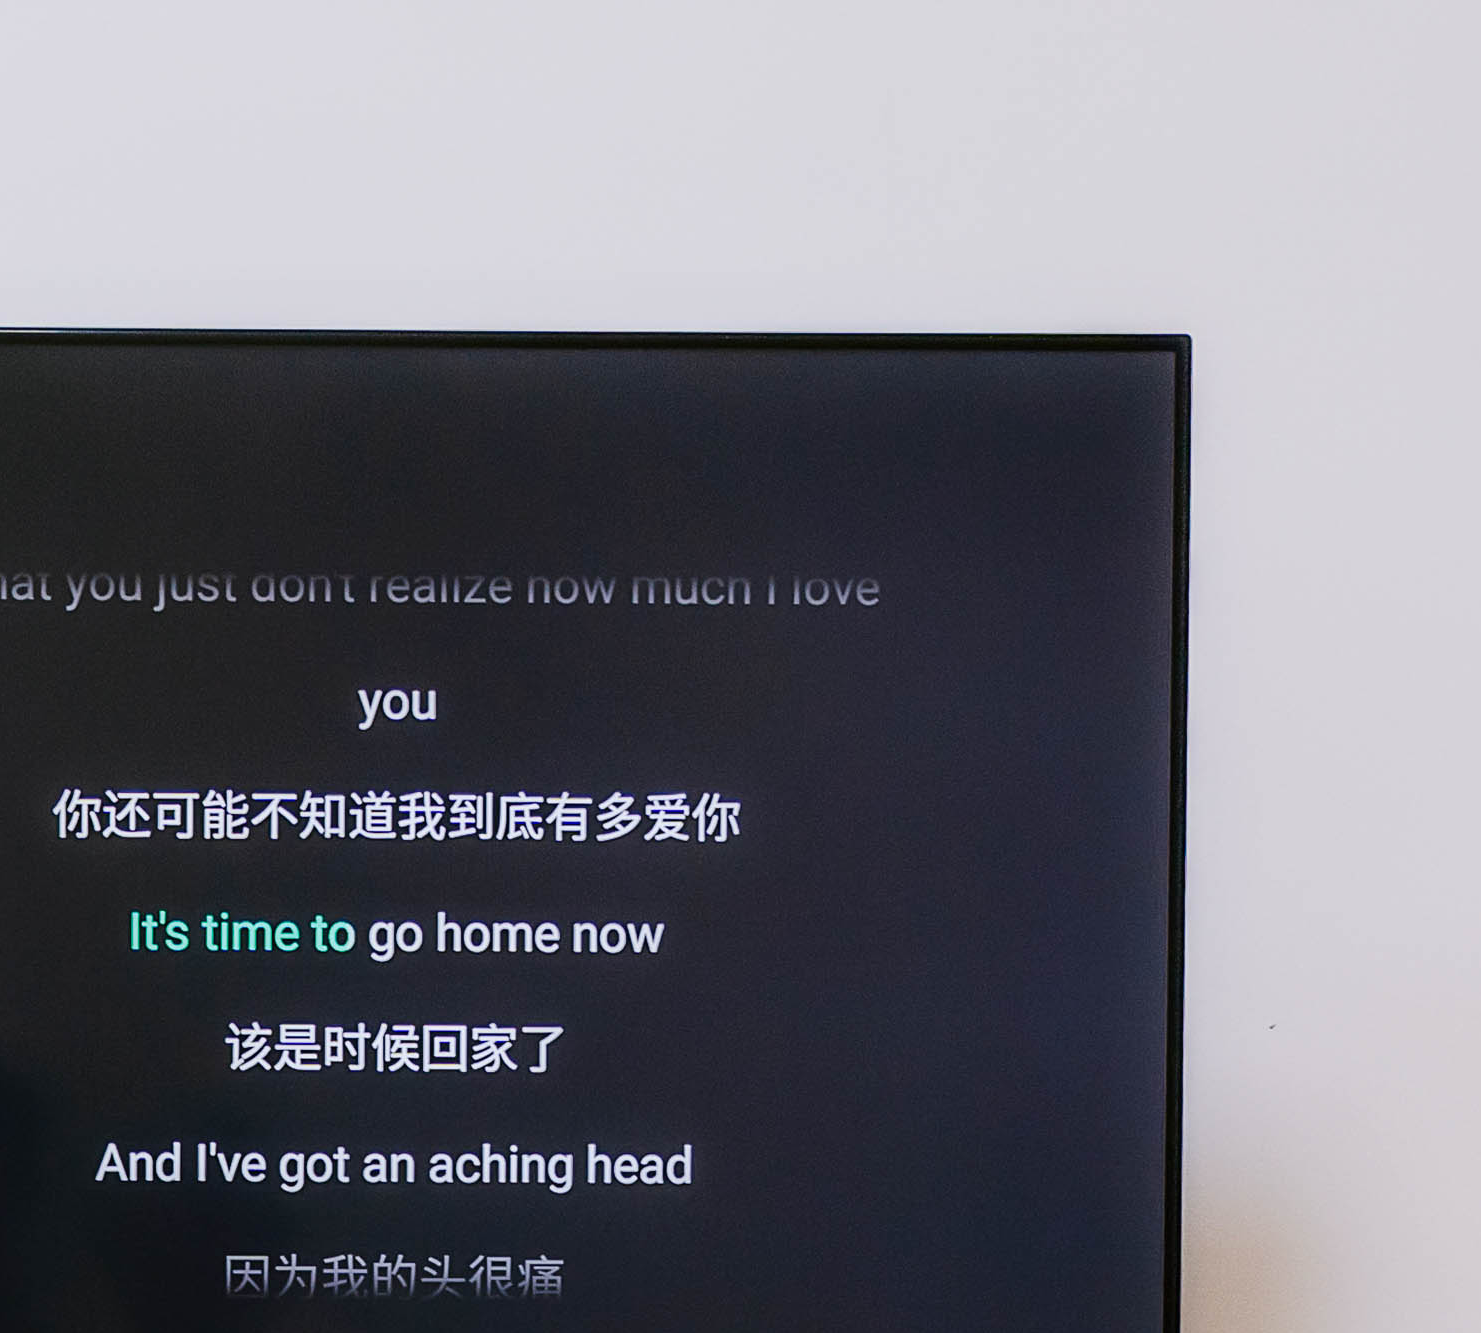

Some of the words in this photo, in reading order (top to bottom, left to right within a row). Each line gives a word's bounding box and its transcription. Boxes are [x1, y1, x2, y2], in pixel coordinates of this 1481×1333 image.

[65, 571, 142, 612] you
[251, 571, 356, 604] dont
[356, 687, 438, 731] you
[51, 788, 742, 844] 你还可能不知道我到底有多爱你
[130, 910, 190, 952] It's
[200, 911, 301, 952] time
[310, 914, 357, 953] to
[368, 919, 424, 963] go
[436, 910, 561, 954] home
[572, 921, 666, 954] now
[224, 1021, 565, 1074] 该是时候回家了
[94, 1140, 182, 1183] And
[197, 1141, 267, 1183] I've
[278, 1146, 351, 1193] got
[362, 1152, 416, 1184] an
[428, 1142, 575, 1194] aching
[587, 1142, 693, 1185] head
[224, 1252, 566, 1297] 因为我的头很痛
